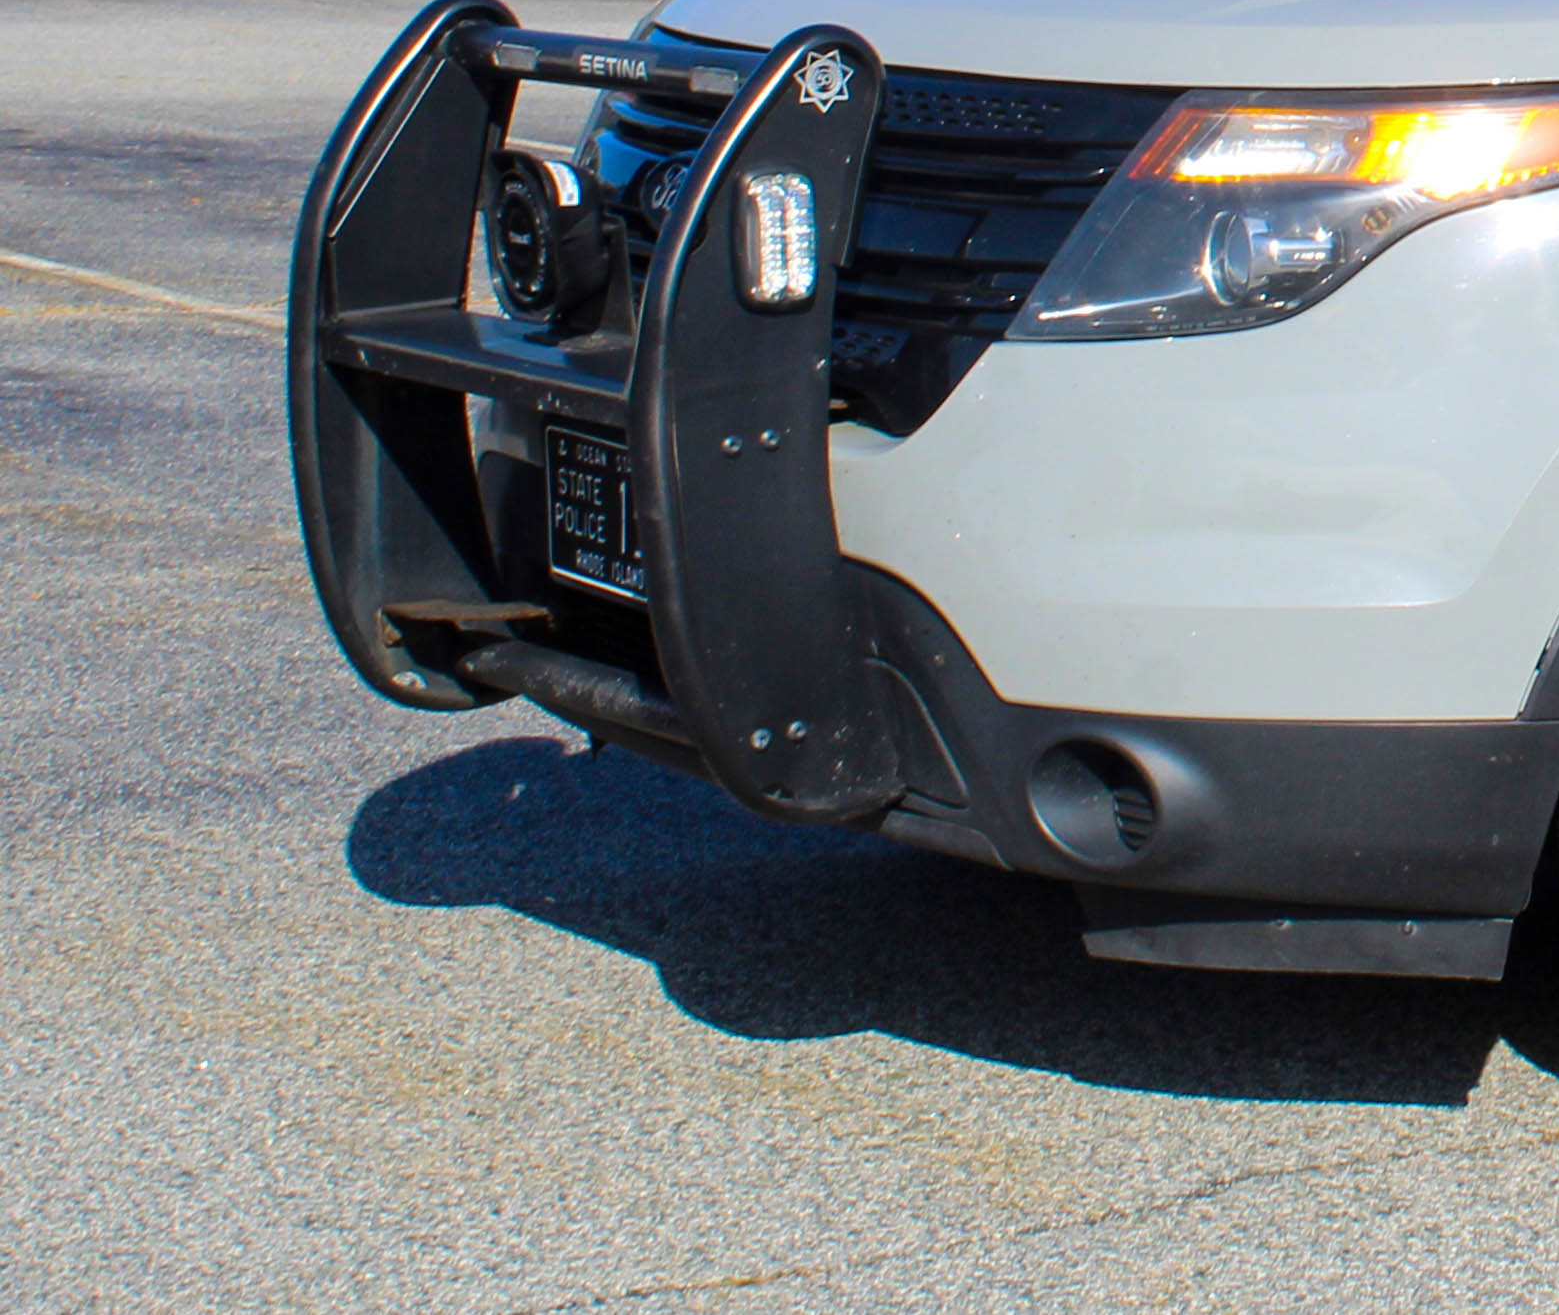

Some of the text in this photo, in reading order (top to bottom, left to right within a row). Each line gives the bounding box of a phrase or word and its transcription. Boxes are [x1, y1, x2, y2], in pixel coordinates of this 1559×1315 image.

[579, 53, 648, 81] SETINA
[558, 468, 602, 506] STATE
[555, 502, 607, 544] POLICE
[576, 548, 646, 590] RHODE ISLAND
